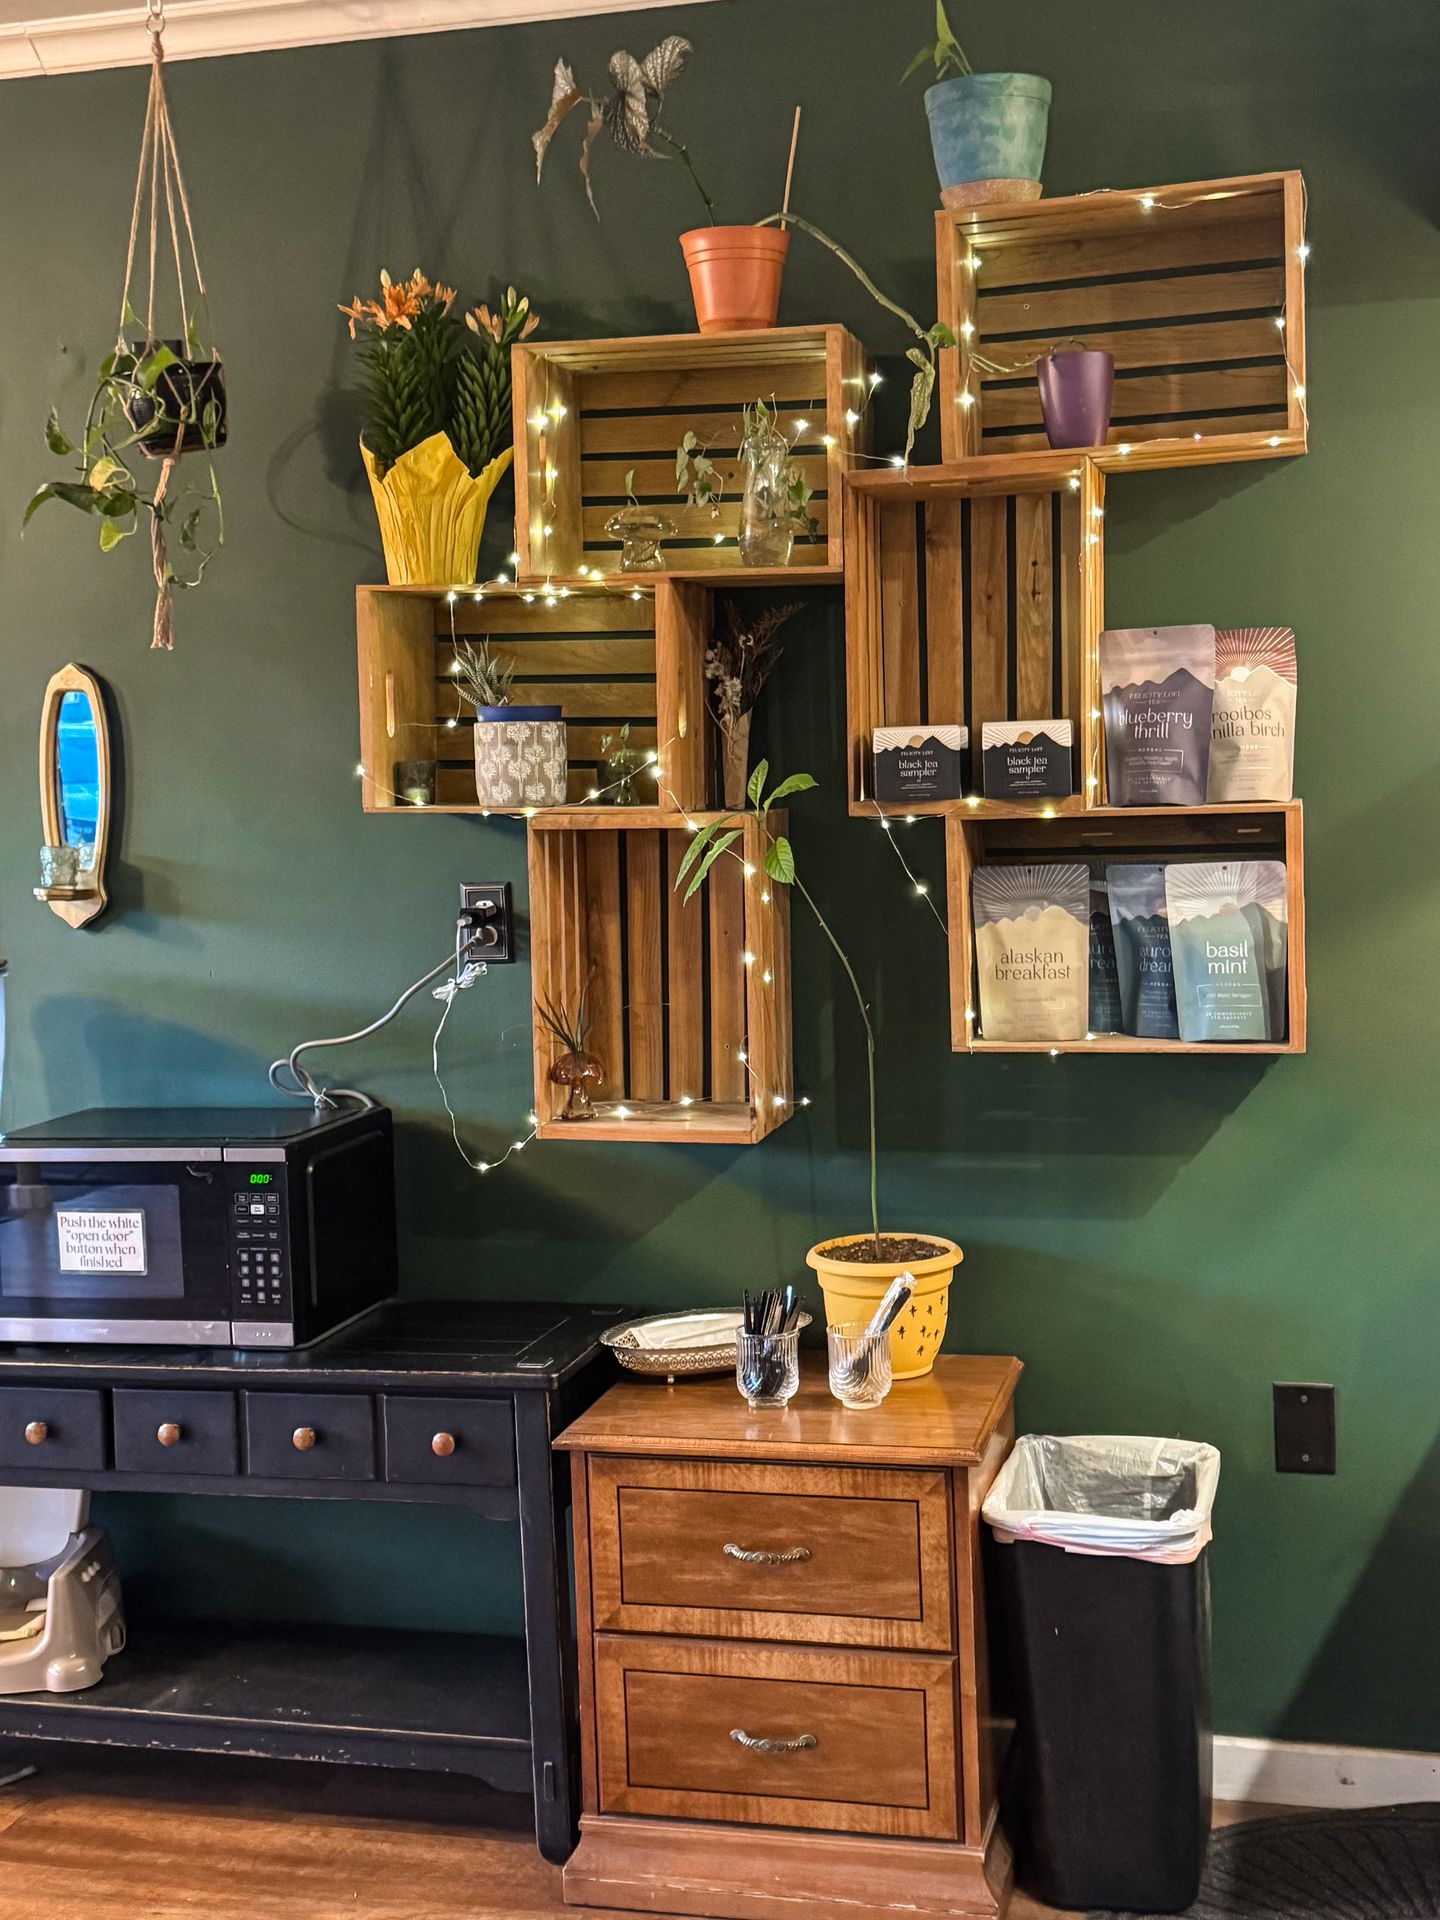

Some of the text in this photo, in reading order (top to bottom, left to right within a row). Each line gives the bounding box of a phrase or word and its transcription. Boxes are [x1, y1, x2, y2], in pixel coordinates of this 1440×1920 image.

[1129, 691, 1161, 700] FELICITY
[1118, 707, 1193, 729] blueberry
[1211, 705, 1272, 723] rooibos
[1134, 722, 1169, 739] thrill
[1211, 721, 1285, 739] nilla birch
[898, 760, 938, 769] black tea
[1007, 756, 1048, 766] black tea
[900, 769, 937, 778] sampler
[1008, 766, 1047, 779] sampler
[1000, 947, 1064, 965] alaskan
[1139, 946, 1171, 958] auro
[1206, 939, 1249, 958] basil
[995, 963, 1072, 981] breakfast
[1139, 957, 1172, 973] drea
[1208, 959, 1247, 974] mint
[60, 1216, 139, 1229] Push the white
[66, 1229, 134, 1244] "open door"
[66, 1241, 136, 1255] button when
[80, 1255, 123, 1268] finished
